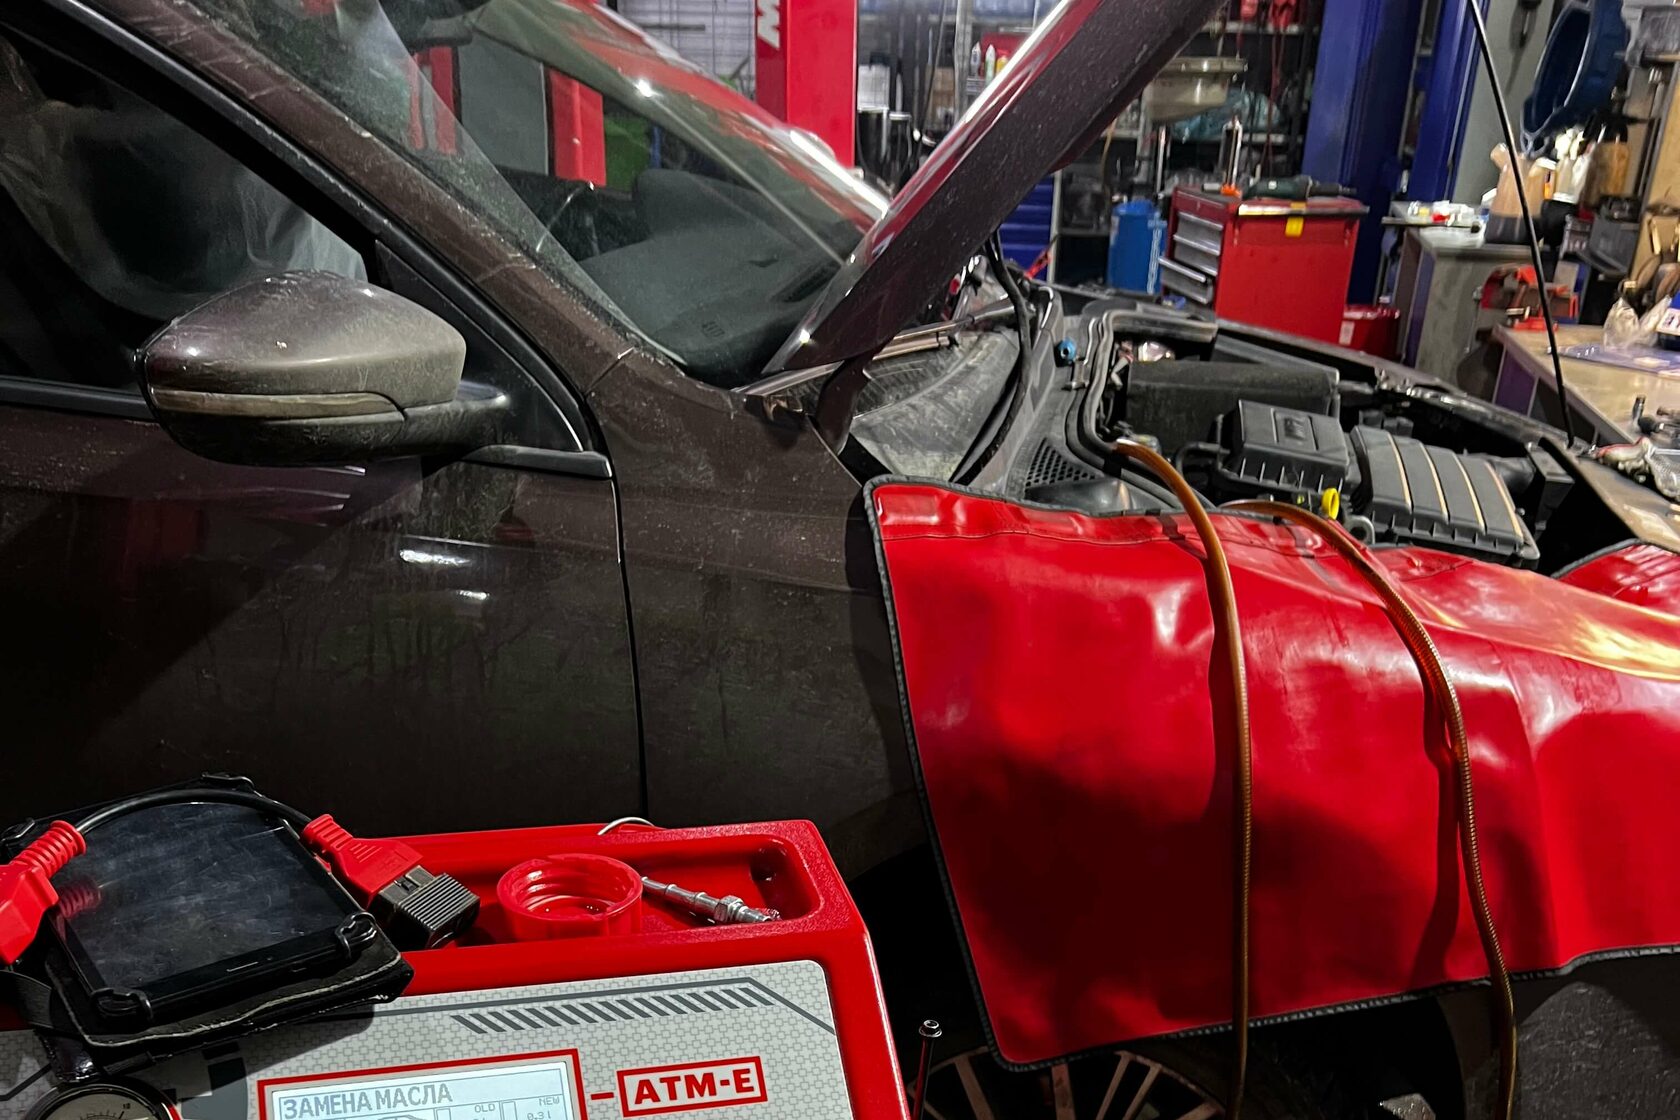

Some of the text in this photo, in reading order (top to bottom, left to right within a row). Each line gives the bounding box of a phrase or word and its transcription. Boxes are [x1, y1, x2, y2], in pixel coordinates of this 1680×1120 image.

[634, 1068, 755, 1105] ATM-E
[283, 1083, 453, 1120] ЗАМЕНА МАСЛА
[474, 1103, 496, 1114] OLD
[538, 1095, 560, 1107] NEW
